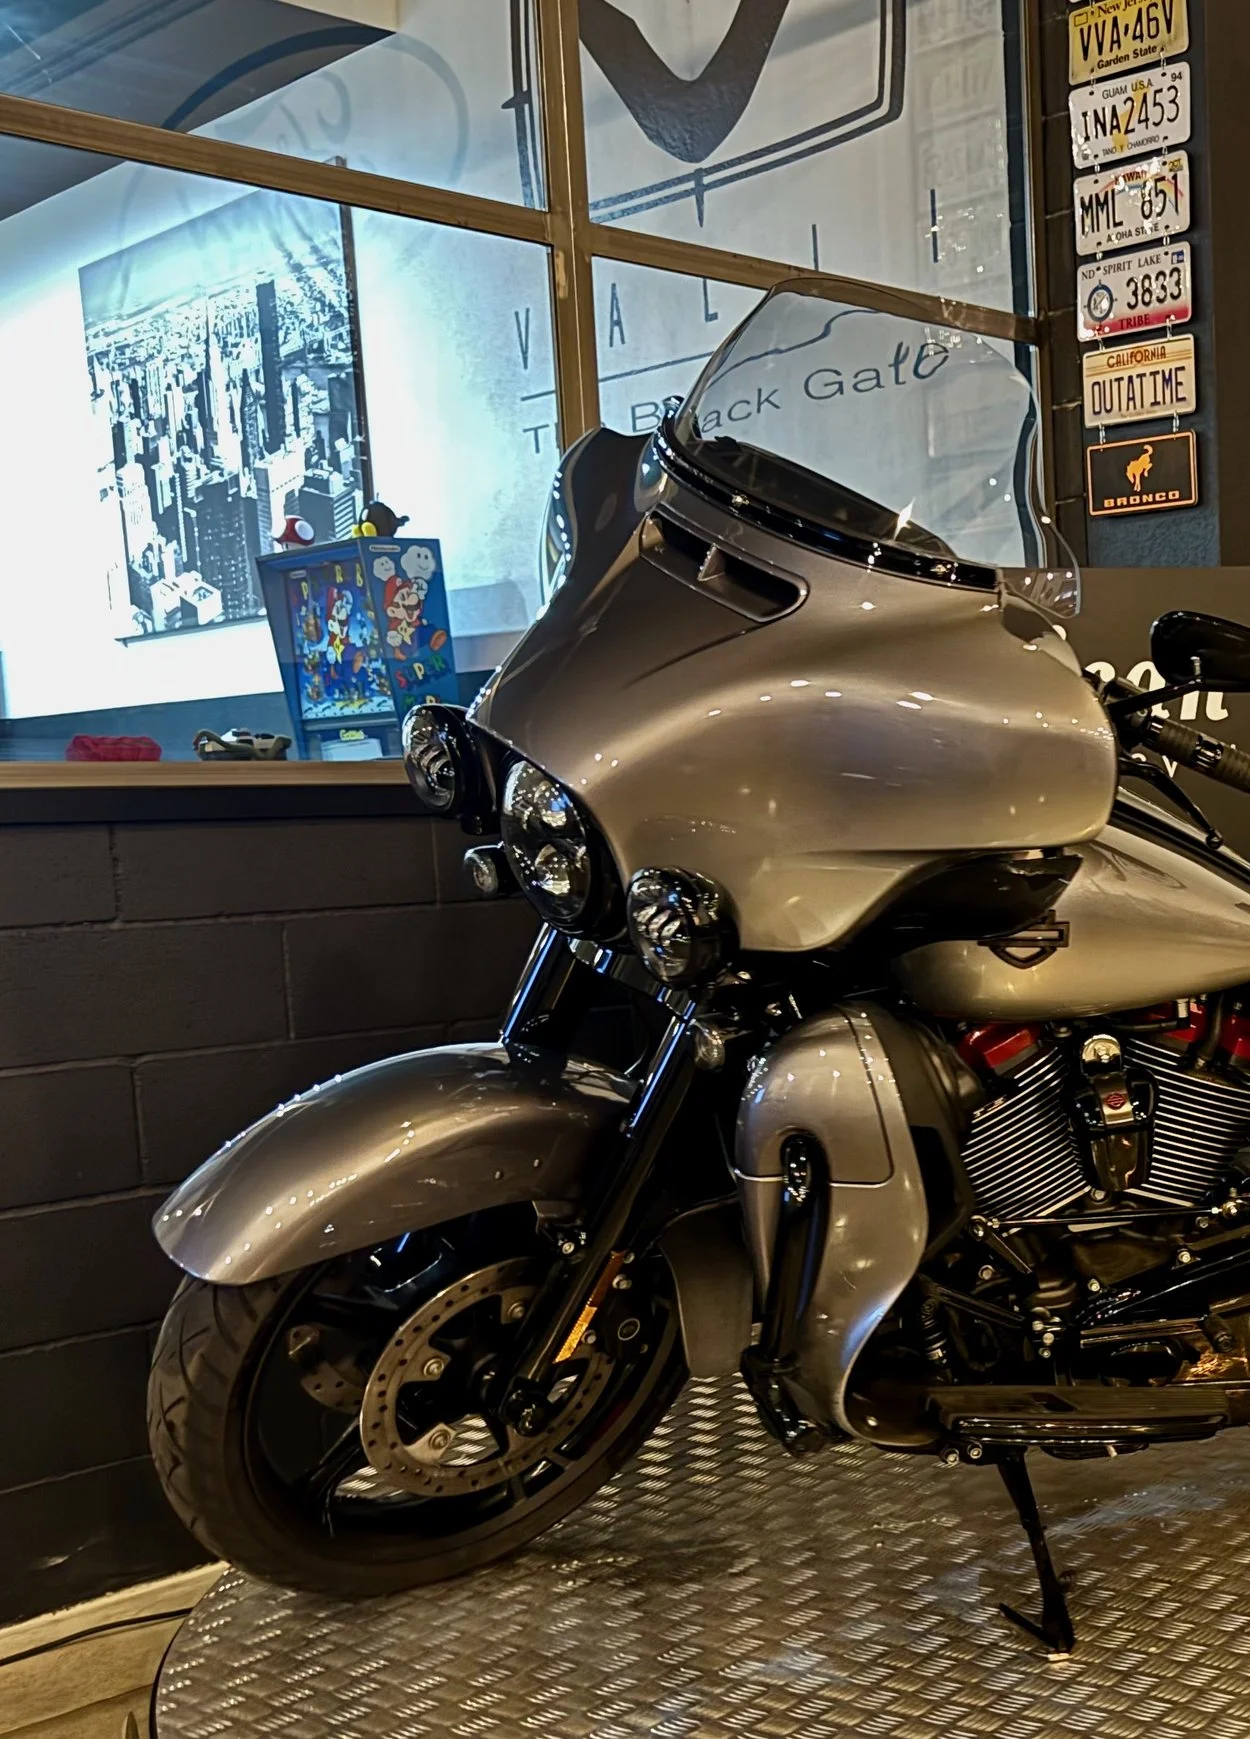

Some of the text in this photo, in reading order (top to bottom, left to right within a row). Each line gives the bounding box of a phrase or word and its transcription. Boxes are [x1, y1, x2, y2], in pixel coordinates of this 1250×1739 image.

[1097, 4, 1121, 18] New
[1097, 45, 1157, 70] Garden State
[1102, 85, 1128, 100] GUAM
[1171, 71, 1183, 82] 94
[1081, 85, 1180, 143] INA2453
[1081, 173, 1180, 236] MML 851
[1106, 223, 1160, 243] AOHA STE
[1081, 269, 1096, 281] ND
[1103, 260, 1133, 276] SPIRIT
[1138, 254, 1162, 268] LAKE
[1126, 267, 1182, 311] 3833
[1120, 314, 1151, 330] TRIBE
[1106, 345, 1167, 369] CALIFORNIA
[630, 341, 950, 434] Back Gate
[1091, 365, 1187, 416] OUTATIME
[1103, 490, 1180, 508] BRONCO
